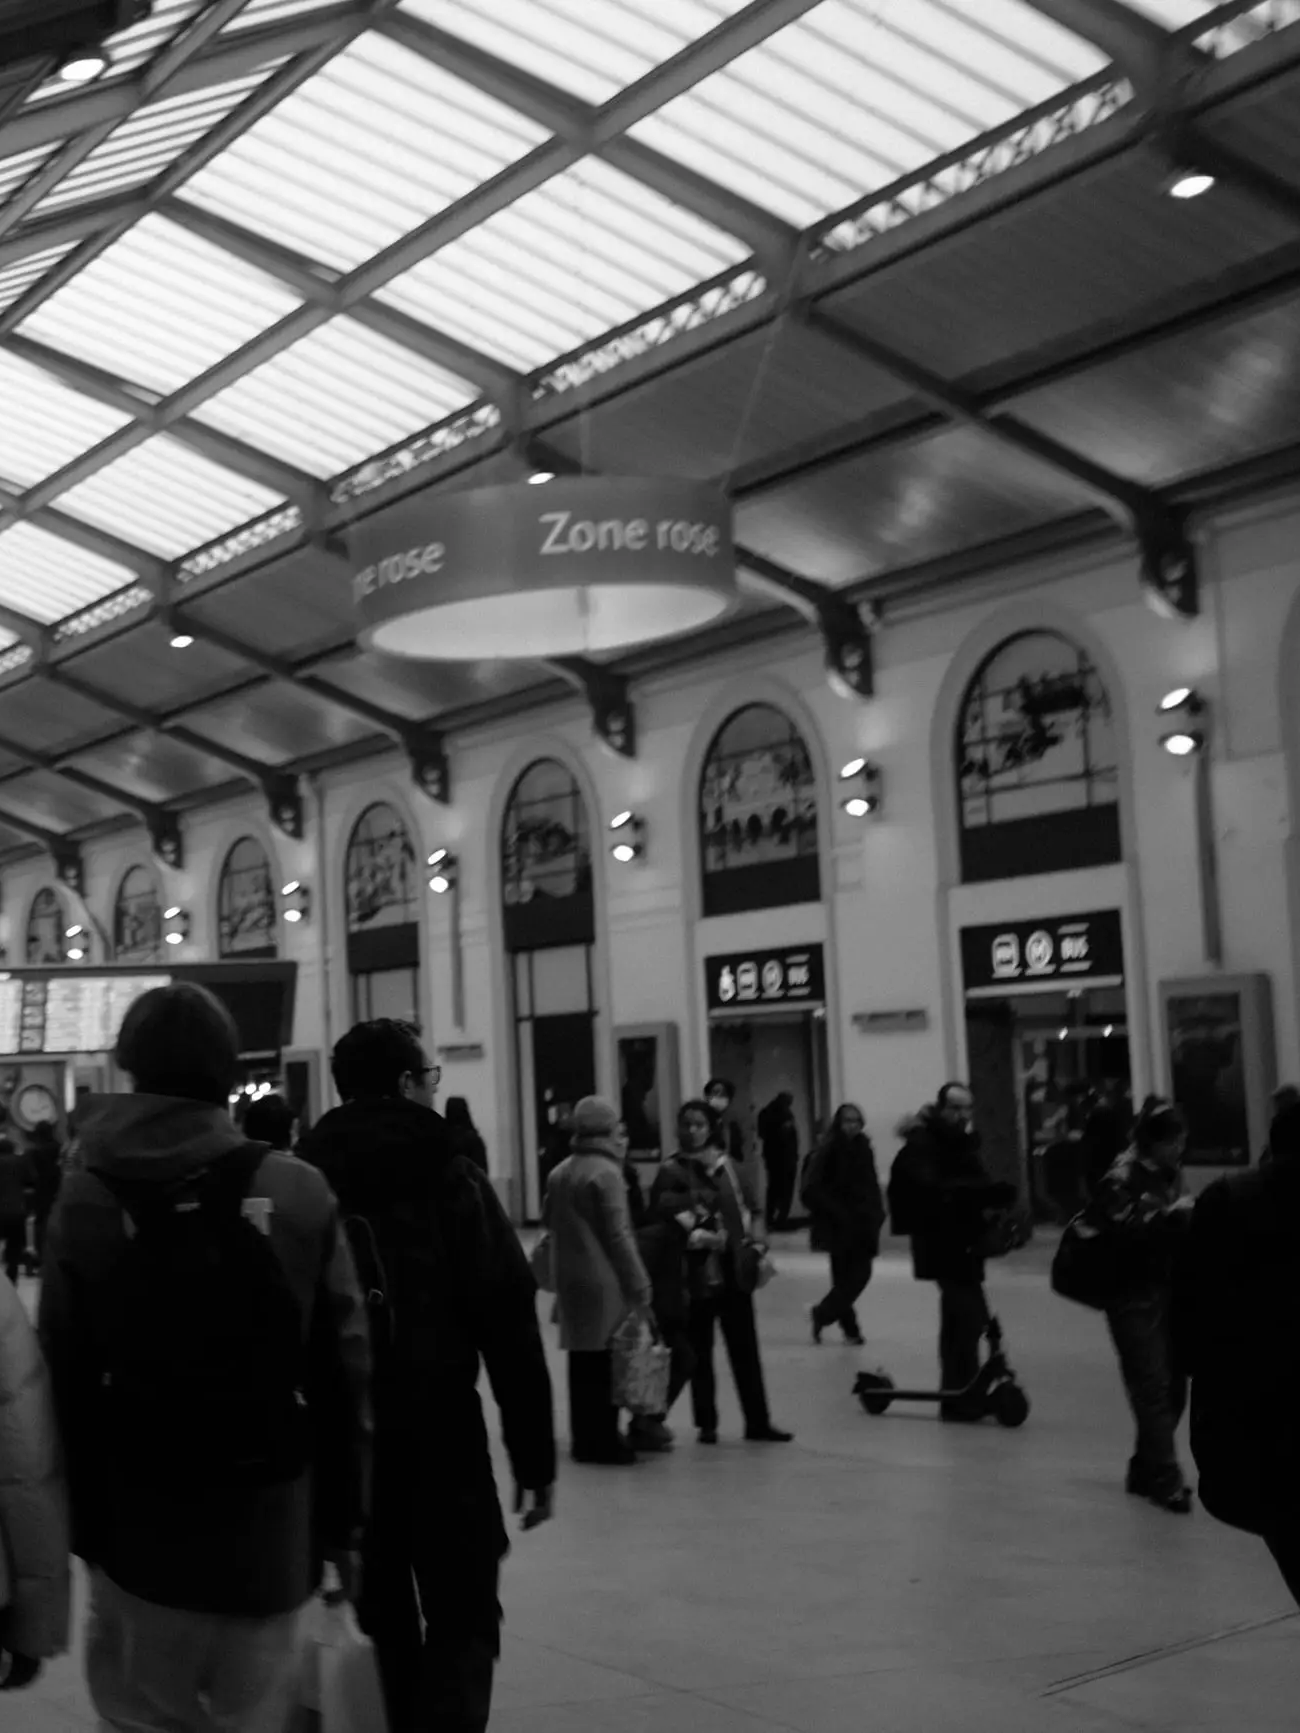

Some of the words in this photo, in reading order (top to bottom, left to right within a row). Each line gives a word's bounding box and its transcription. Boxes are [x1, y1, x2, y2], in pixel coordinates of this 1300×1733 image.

[538, 511, 649, 555] Zone
[656, 519, 720, 557] rose
[378, 541, 446, 589] rose
